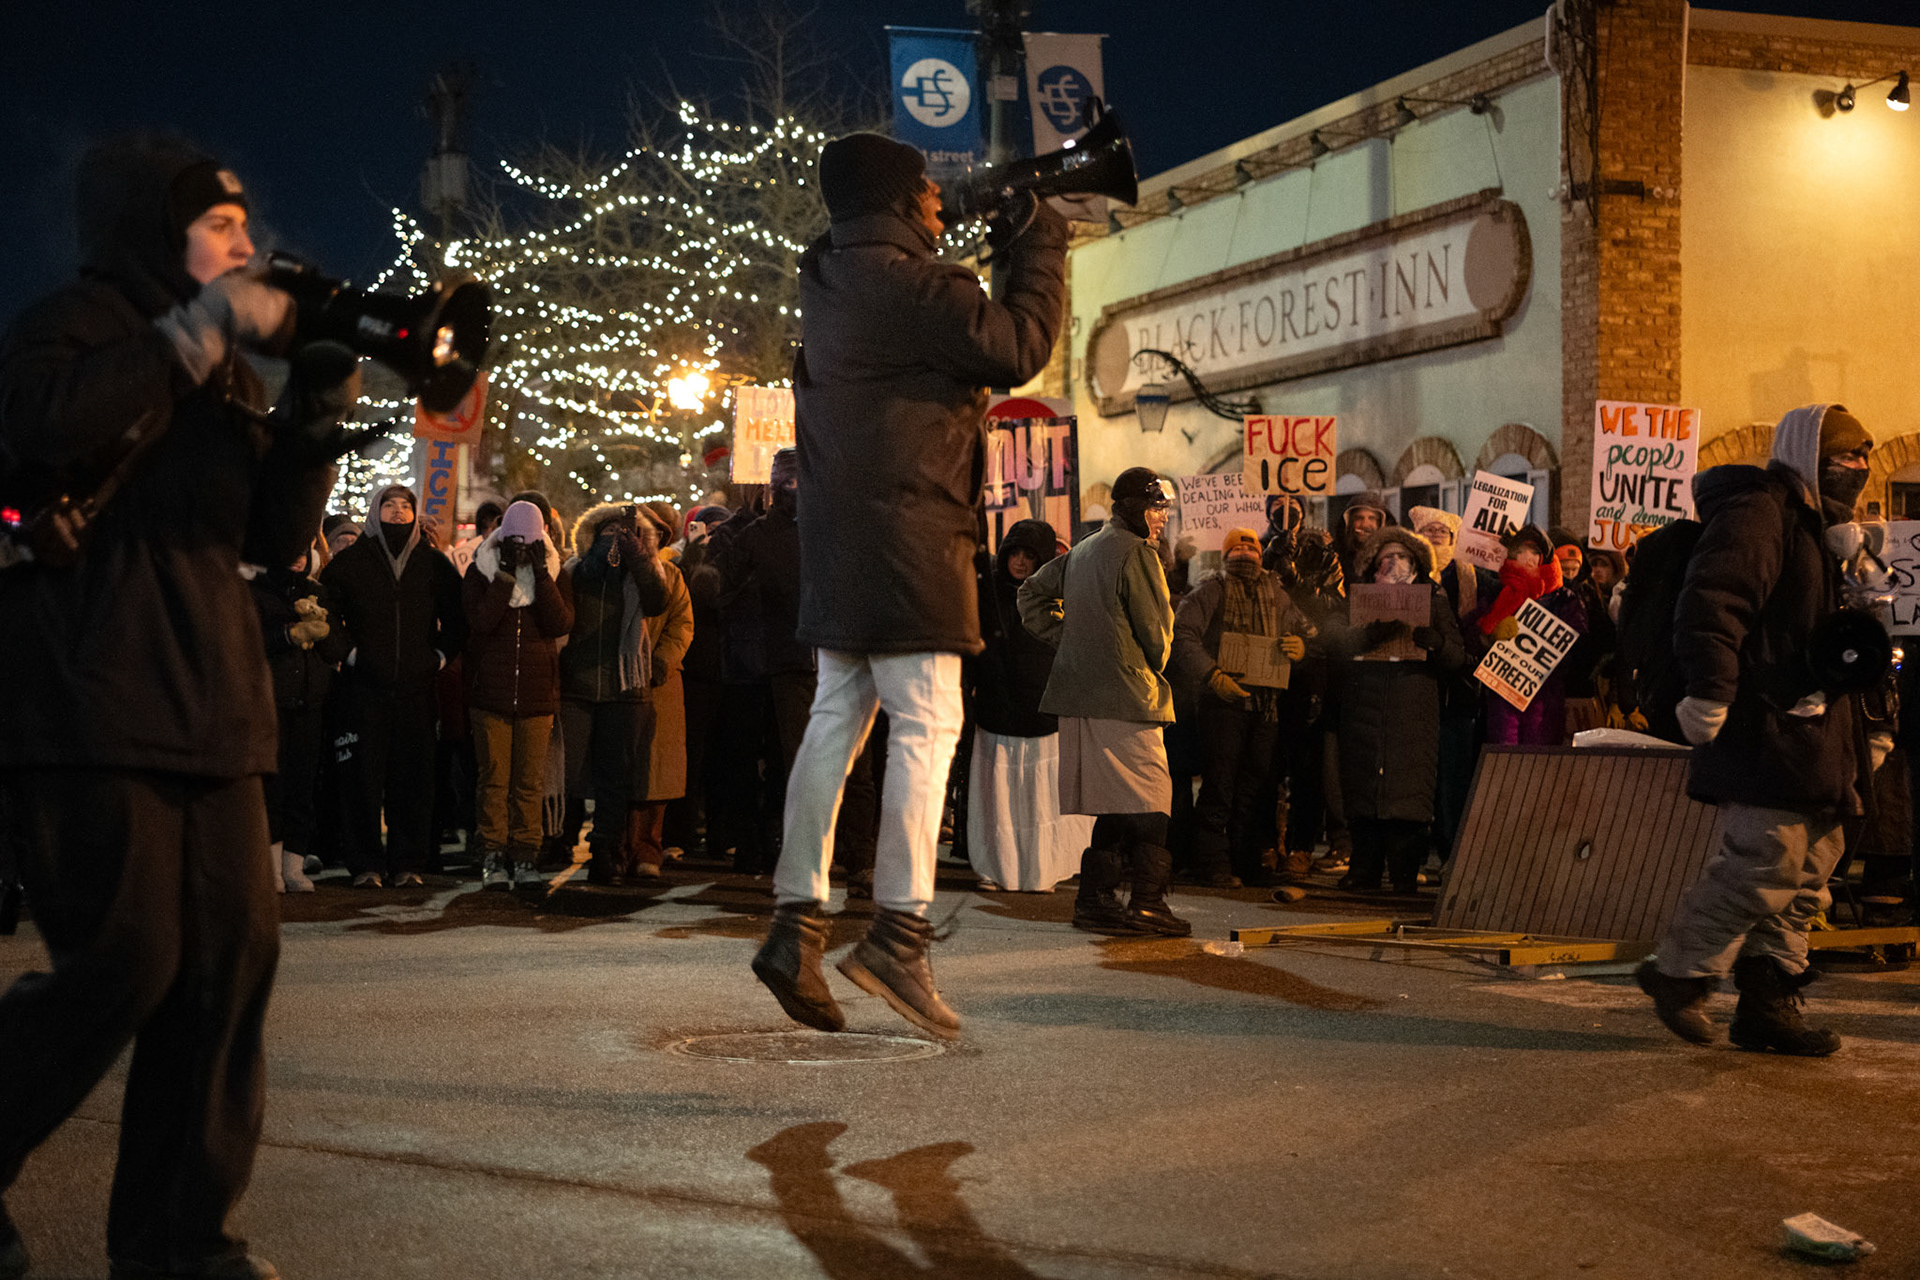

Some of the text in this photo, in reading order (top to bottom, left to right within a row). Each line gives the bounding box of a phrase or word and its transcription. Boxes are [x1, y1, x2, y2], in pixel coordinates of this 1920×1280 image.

[1138, 243, 1451, 375] BLACK FOREST INN
[1248, 418, 1335, 457] FUCK
[1600, 405, 1694, 441] WE THE
[1604, 442, 1687, 483] people
[1181, 476, 1217, 491] WE'VE
[1182, 489, 1235, 504] DEALING
[1473, 480, 1529, 504] LEGALIZATION
[1600, 471, 1684, 512] UNITE
[1206, 503, 1229, 515] OUR
[1487, 496, 1508, 511] FOR
[1596, 503, 1626, 522] and
[1184, 516, 1221, 531] LIVES.
[1465, 546, 1502, 563] MIRAC
[1517, 602, 1575, 653] KILLER
[1483, 651, 1538, 698] STREETS
[1496, 642, 1545, 680] OFF OUR
